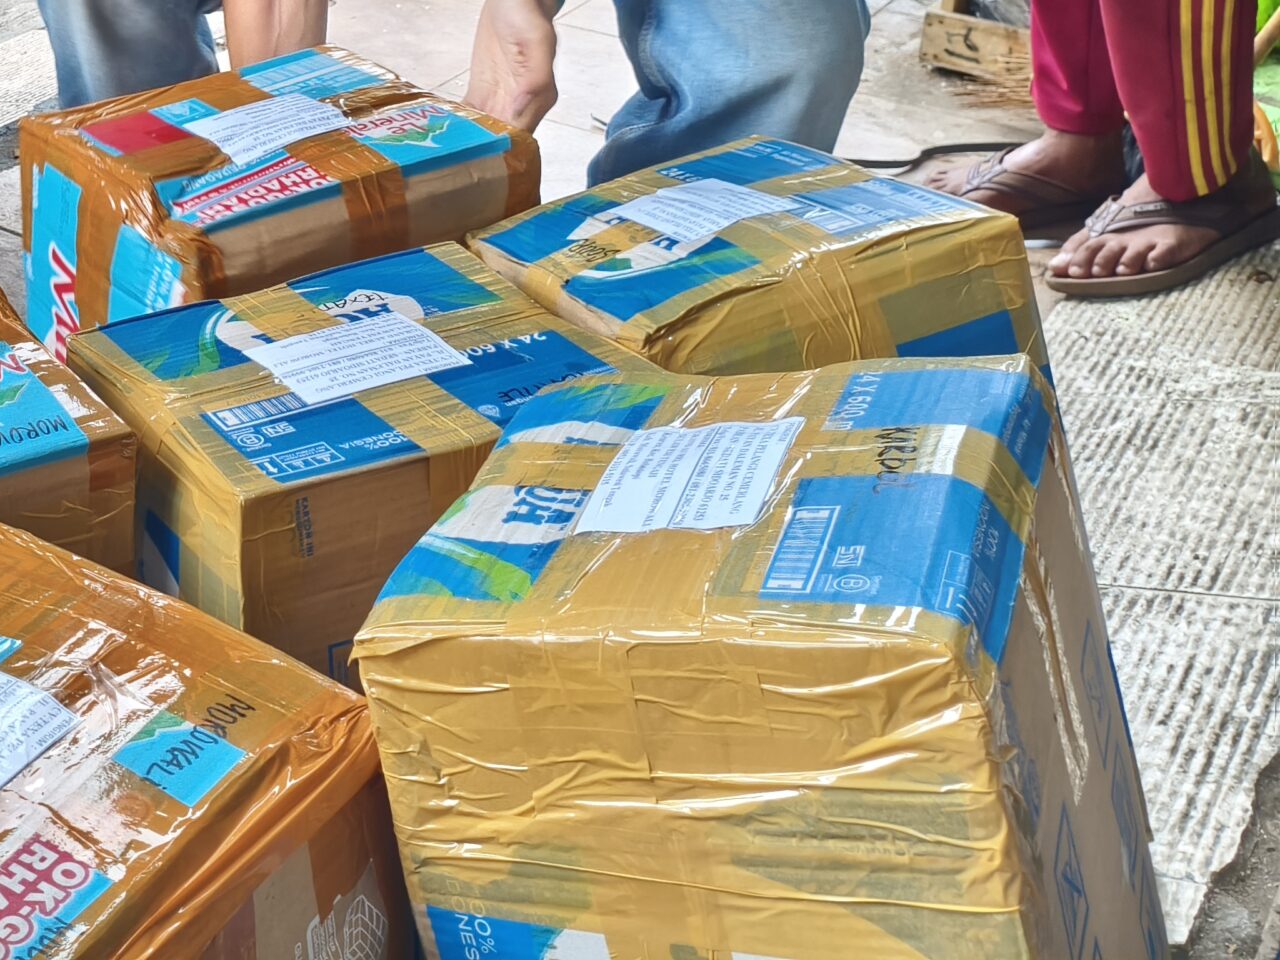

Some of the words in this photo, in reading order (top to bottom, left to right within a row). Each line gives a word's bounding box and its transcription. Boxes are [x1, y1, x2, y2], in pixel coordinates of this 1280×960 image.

[723, 448, 750, 480] DALEMAN
[744, 443, 769, 470] PELANGI
[698, 469, 726, 502] SIDOARJO
[724, 471, 758, 514] CEMERLANG
[691, 503, 711, 521] 61253
[33, 715, 75, 747] PENGIRIM
